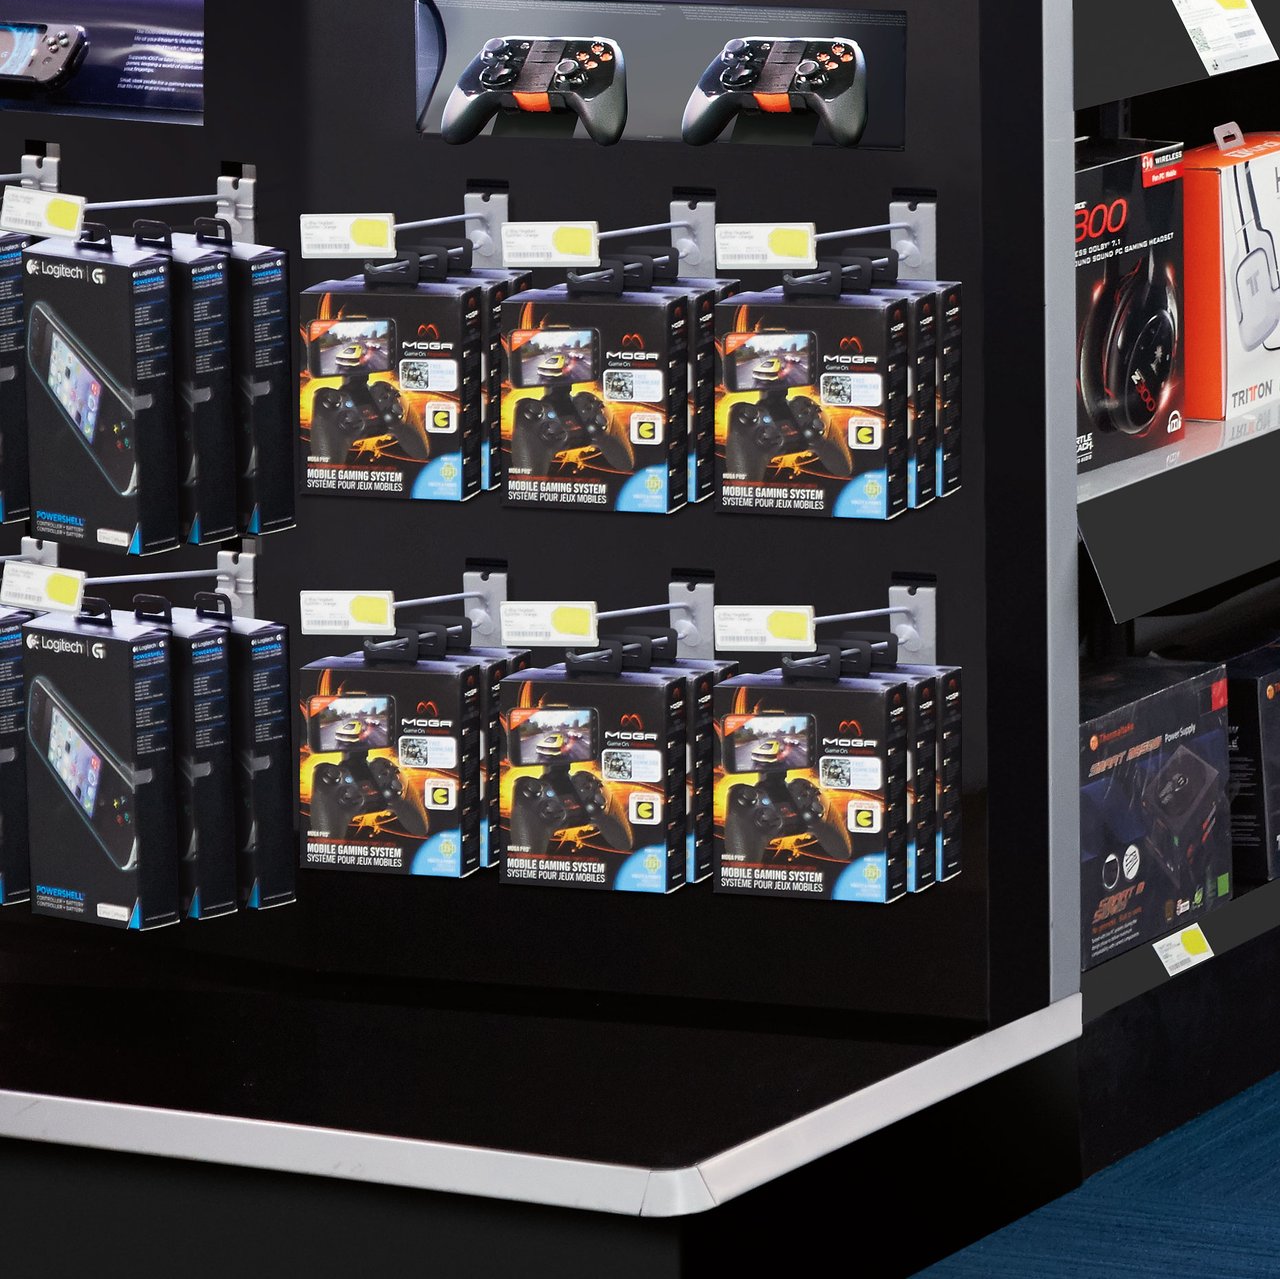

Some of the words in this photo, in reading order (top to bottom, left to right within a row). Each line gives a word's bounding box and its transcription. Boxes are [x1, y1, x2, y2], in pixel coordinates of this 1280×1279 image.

[1155, 151, 1182, 164] WIRELESS
[1124, 241, 1147, 254] GAMING
[1148, 232, 1174, 247] HEADSET
[42, 262, 83, 279] Logitech
[402, 341, 453, 351] MOGA
[823, 354, 878, 365] MOGA
[307, 469, 336, 480] MOBILE
[338, 471, 369, 481] GAMING
[370, 472, 403, 483] SYSTEM
[338, 480, 355, 490] POUR
[356, 481, 372, 491] JEUX
[374, 482, 403, 492] MOBILES
[36, 510, 84, 526] POWERSHELL
[42, 635, 83, 654] Logitech
[1164, 730, 1180, 743] Power
[1180, 723, 1196, 738] Supply
[822, 738, 876, 748] MOGA
[721, 868, 751, 880] MOBILE
[754, 869, 786, 882] GAMING
[789, 871, 822, 883] SYSTEM
[37, 885, 84, 901] POWERSHELL
[754, 880, 772, 890] POUR
[774, 881, 790, 892] JEUX
[792, 882, 823, 893] MOBILES
